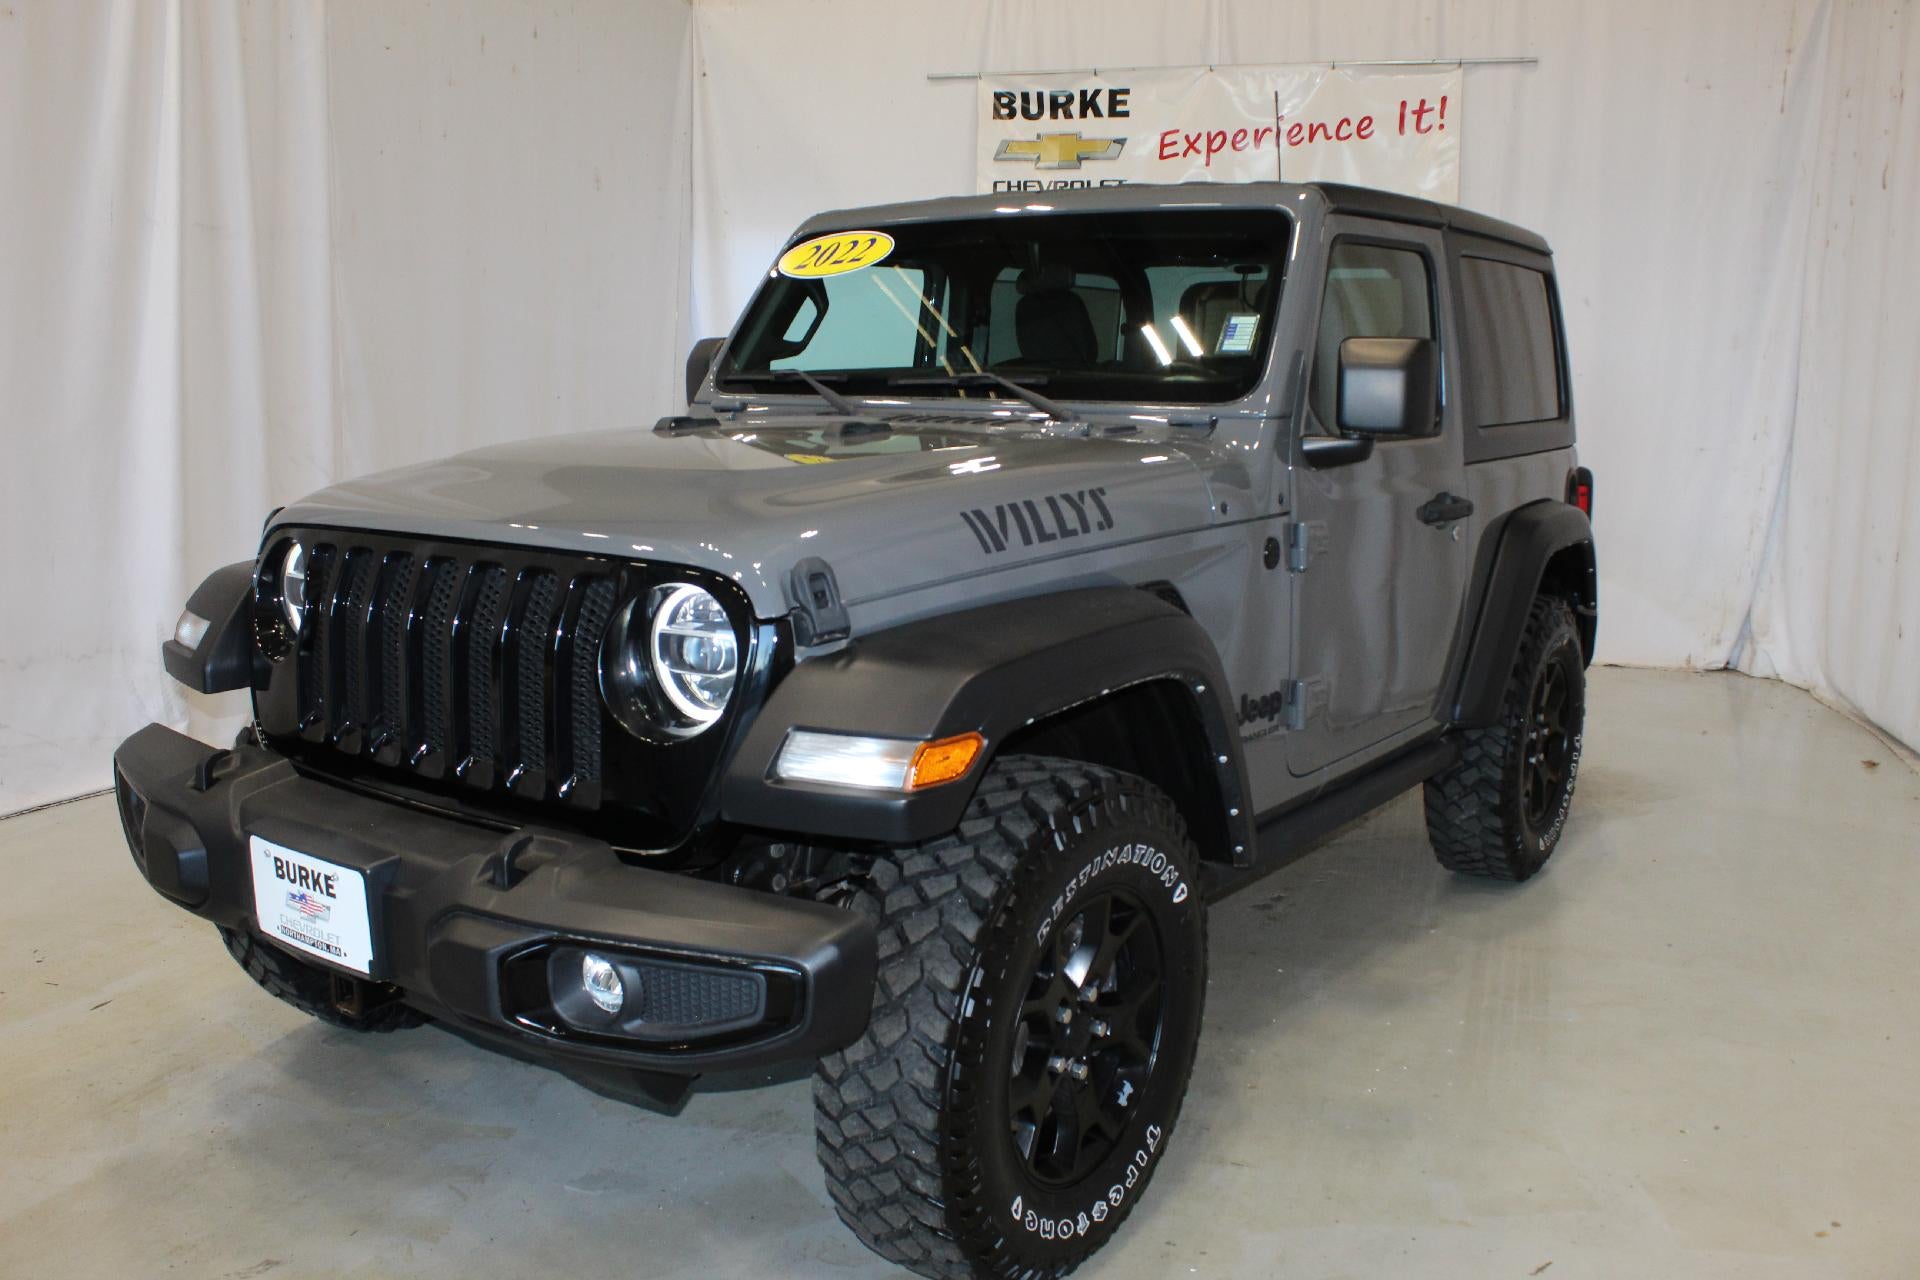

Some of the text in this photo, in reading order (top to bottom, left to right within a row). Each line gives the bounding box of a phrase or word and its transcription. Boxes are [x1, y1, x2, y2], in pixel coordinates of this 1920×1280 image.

[993, 88, 1130, 120] BURKE
[1159, 96, 1448, 167] Experience It!
[793, 237, 877, 269] 2022
[960, 487, 1114, 554] WILLYS
[1236, 691, 1282, 727] Jeep
[274, 856, 337, 898] BURKE
[1037, 843, 1180, 947] DESTINATION
[280, 914, 341, 945] CHEVROLET
[1026, 1125, 1162, 1240] Firestone
